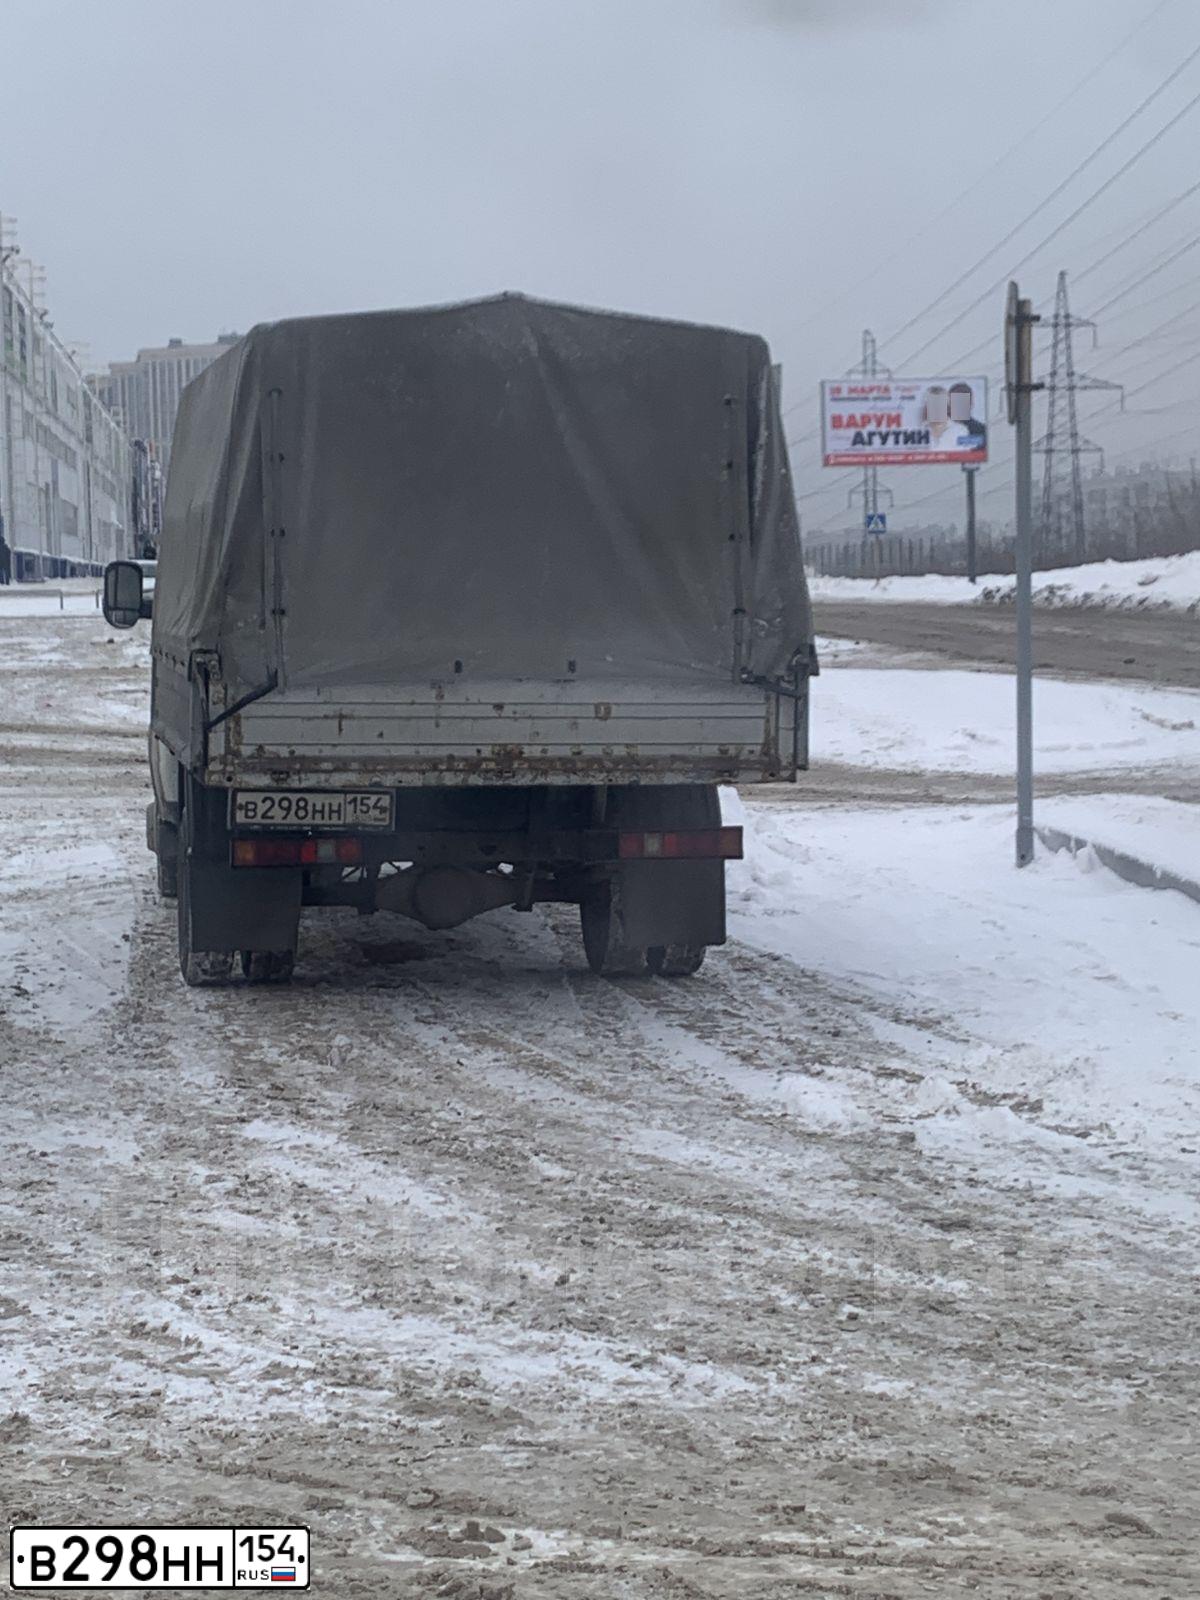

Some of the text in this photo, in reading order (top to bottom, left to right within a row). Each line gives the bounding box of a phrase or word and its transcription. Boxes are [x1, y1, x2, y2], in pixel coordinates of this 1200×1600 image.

[851, 429, 931, 446] АГУТИН
[244, 796, 385, 820] В298НН 154
